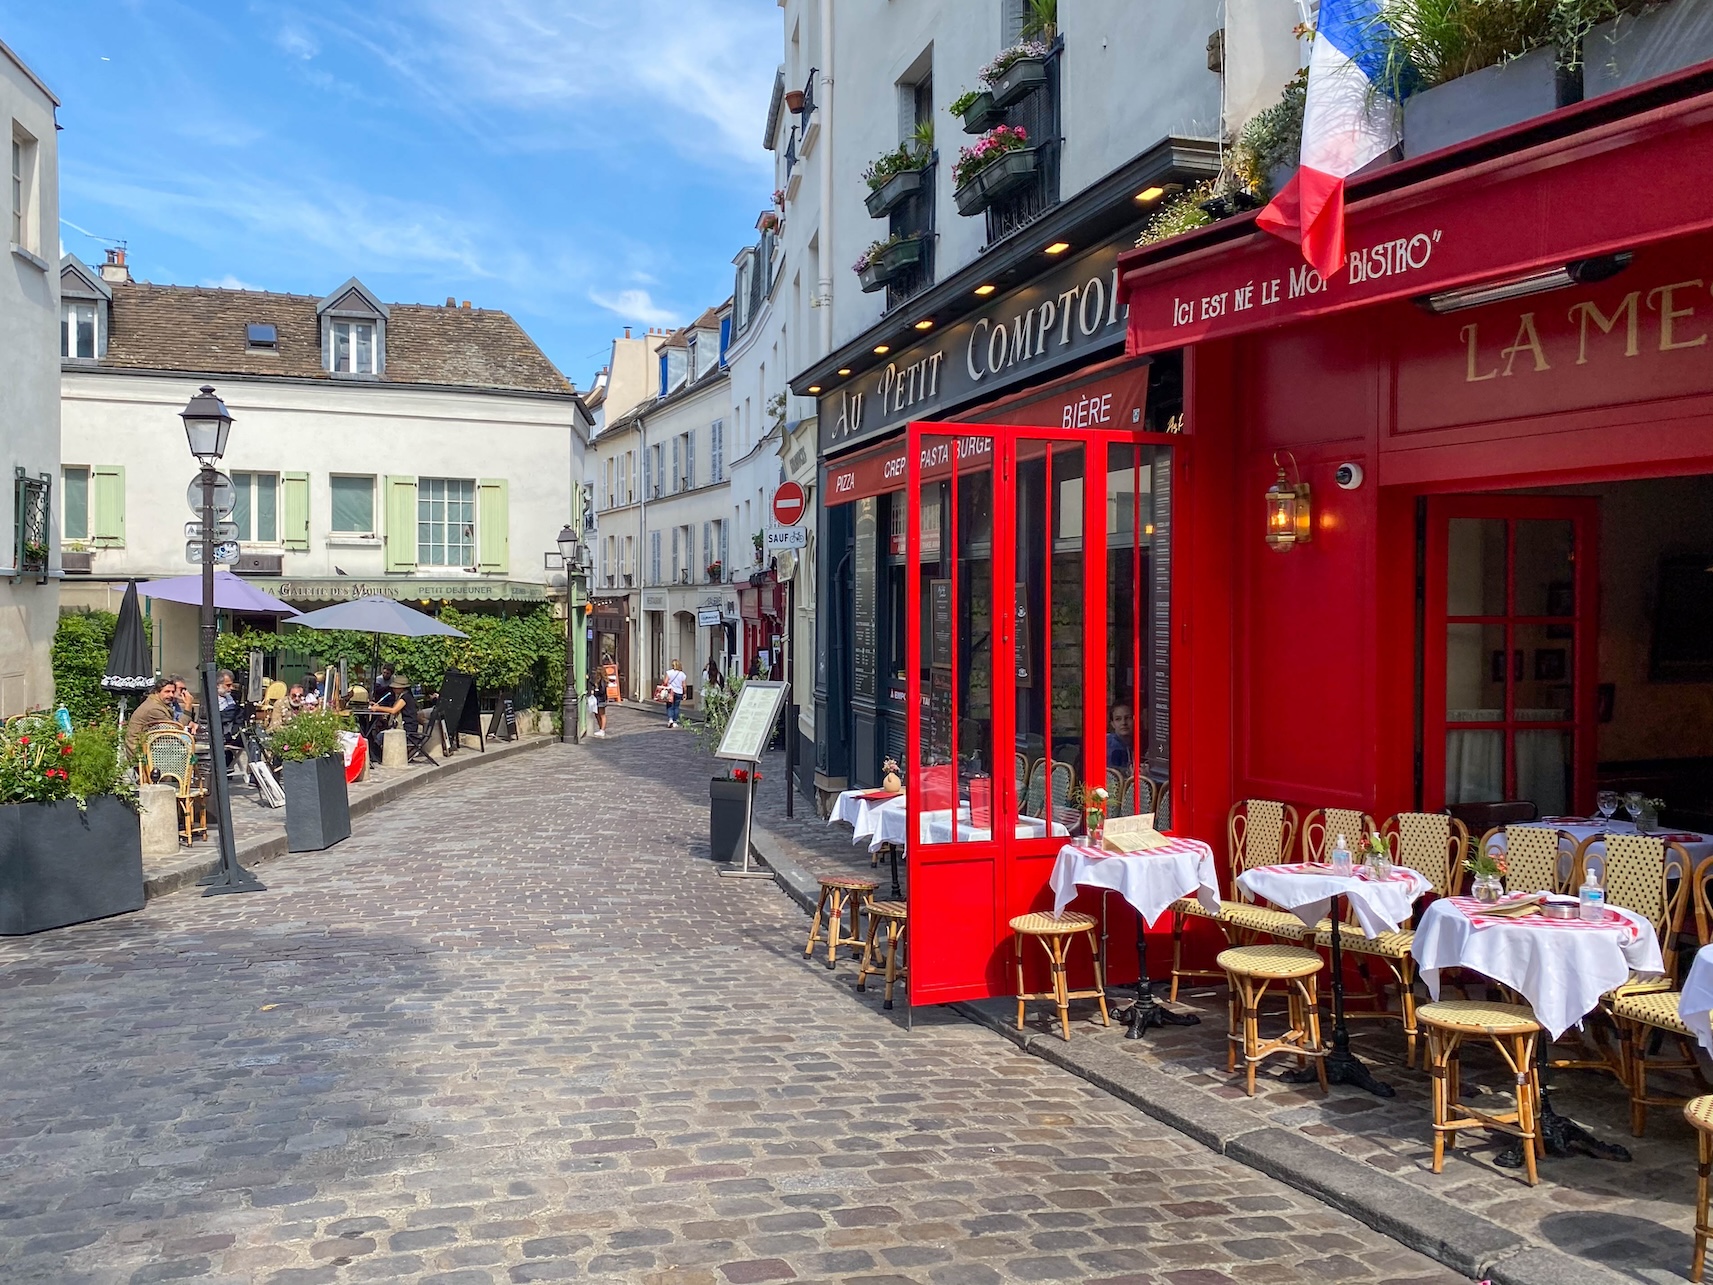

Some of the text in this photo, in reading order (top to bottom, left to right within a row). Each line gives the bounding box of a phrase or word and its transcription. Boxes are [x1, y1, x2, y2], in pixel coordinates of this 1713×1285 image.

[1173, 298, 1194, 327] ICI
[1201, 292, 1228, 320] EST
[1234, 281, 1253, 312] NÉ
[1261, 279, 1280, 305] LE
[1459, 278, 1713, 383] LA ME
[832, 268, 1129, 439] AU PETIT COMPTOI
[835, 394, 1113, 493] PIZZA CREP PASTA BURGE BIÈRE
[768, 533, 789, 543] SAUF
[418, 586, 443, 594] PETIT
[446, 586, 493, 595] DEJEUNER
